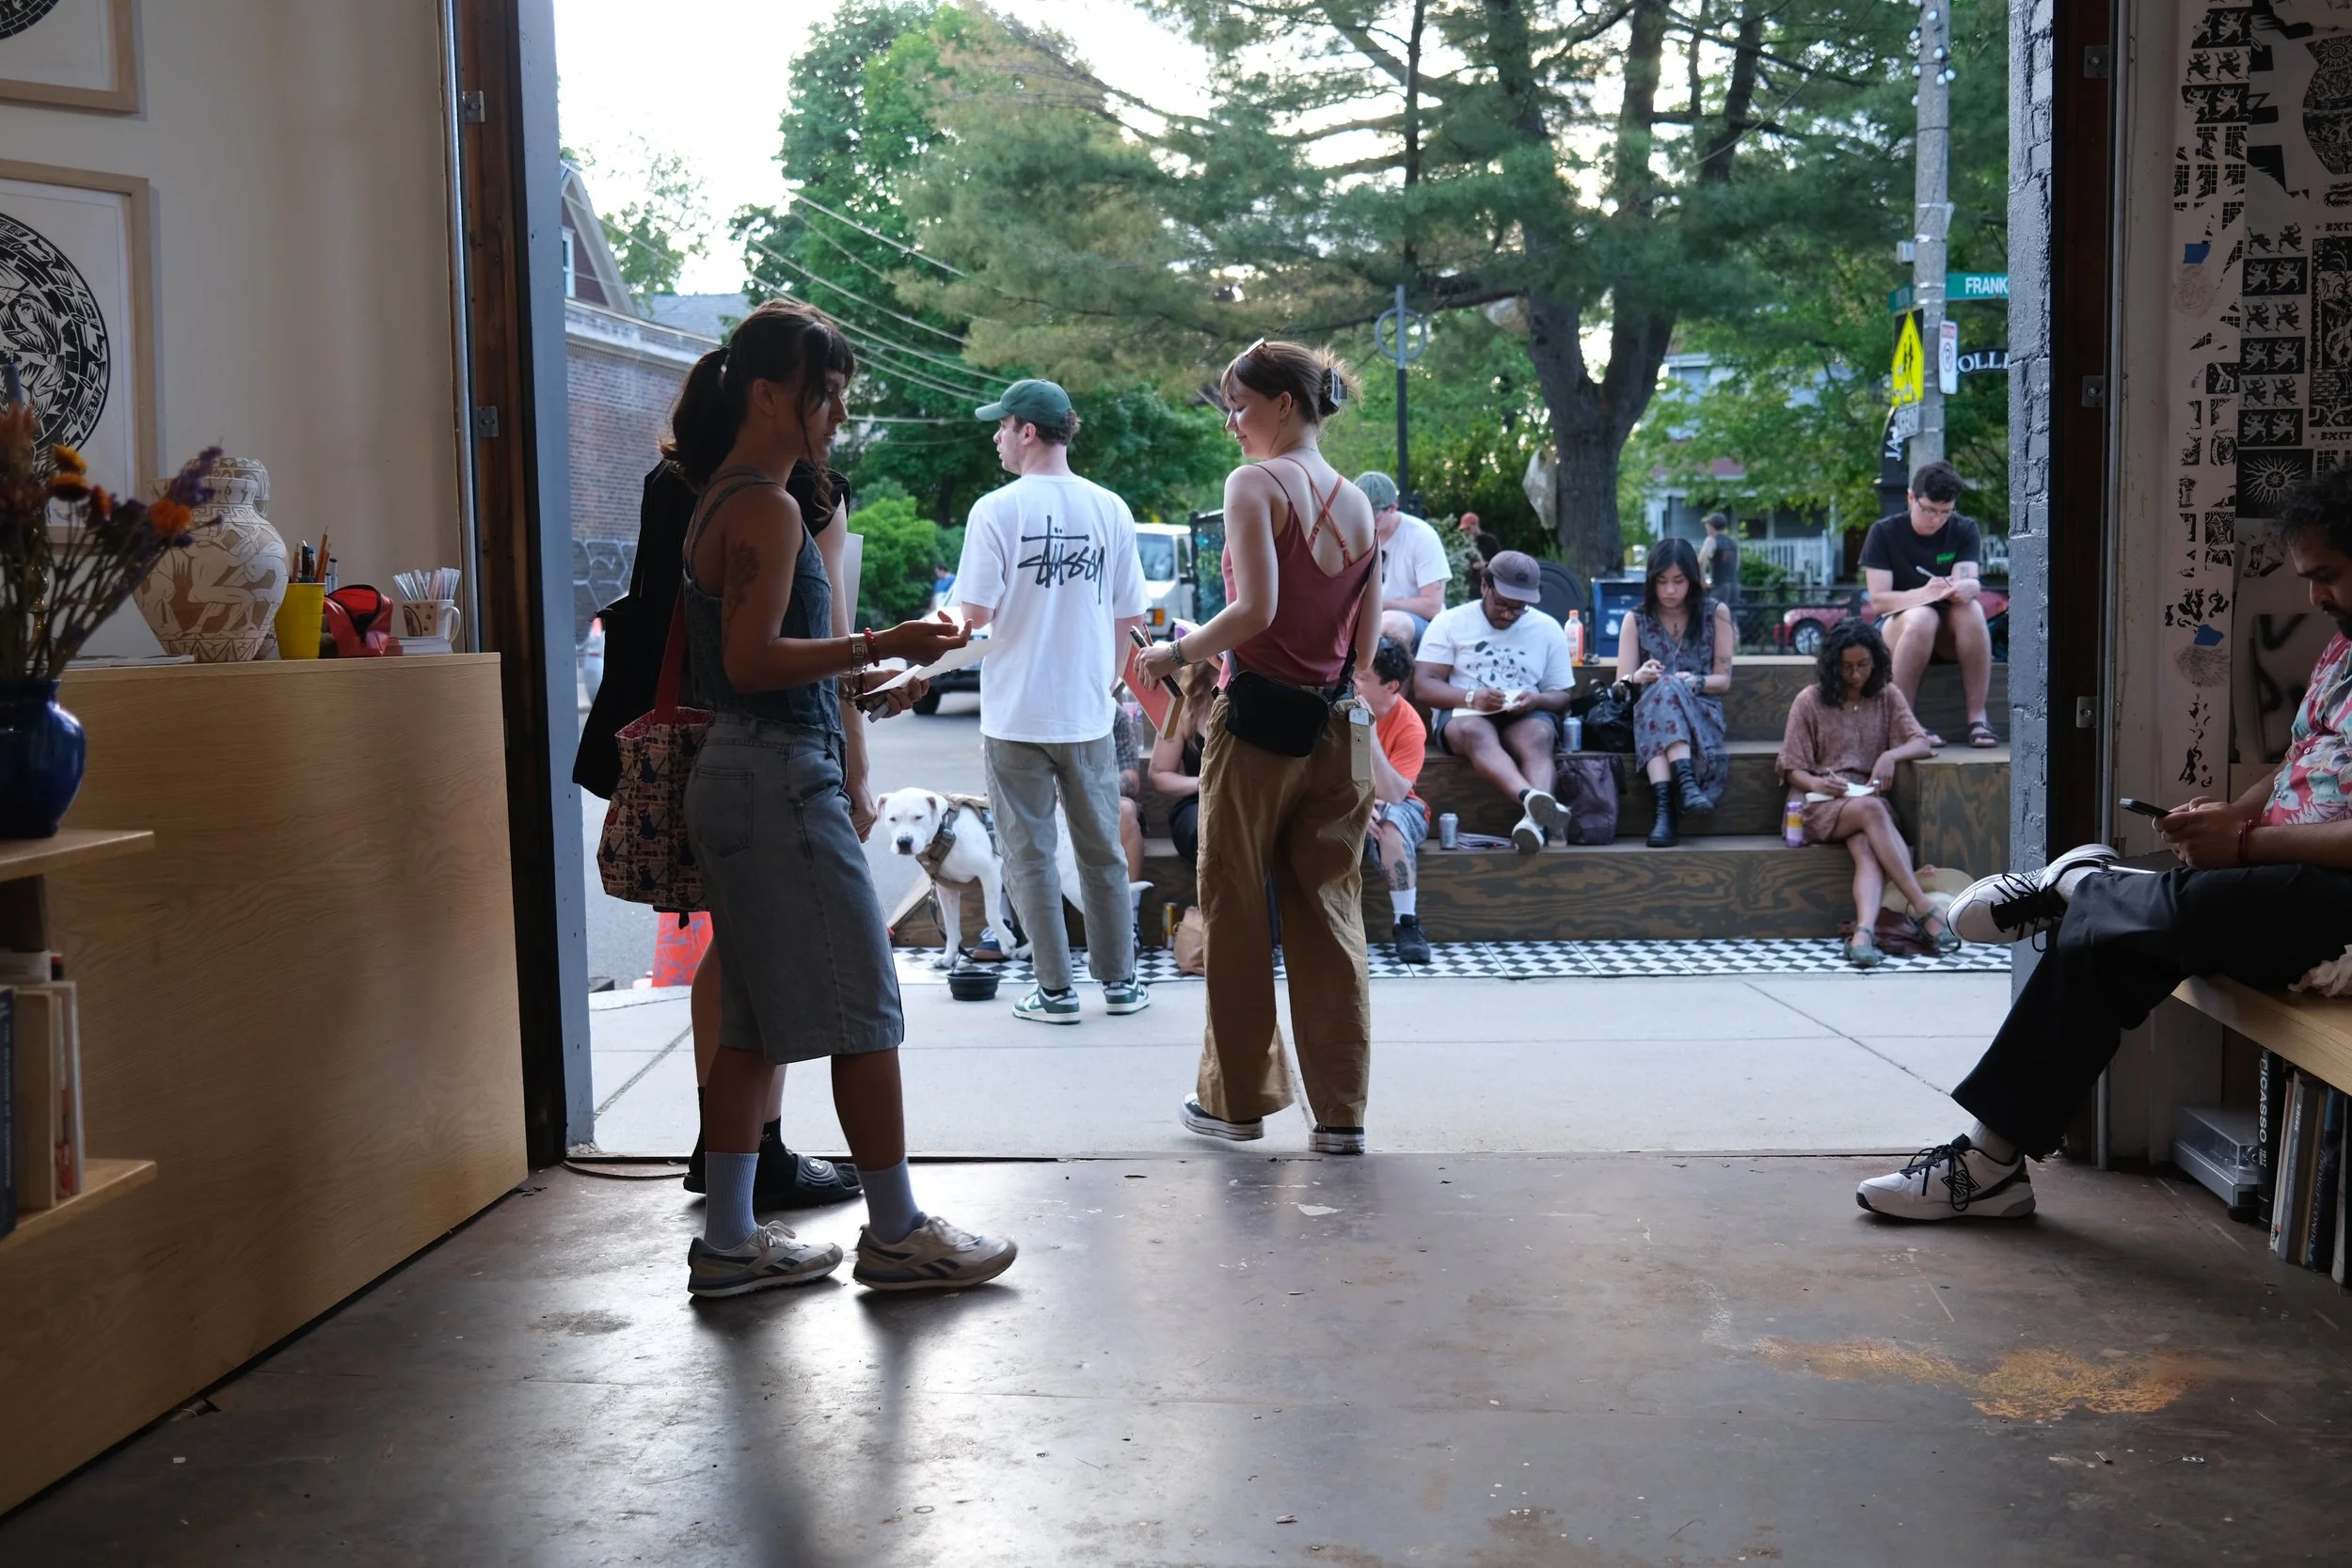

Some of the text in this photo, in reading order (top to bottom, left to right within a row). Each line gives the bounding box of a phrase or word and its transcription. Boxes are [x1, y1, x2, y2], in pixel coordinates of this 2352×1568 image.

[1965, 277, 2009, 294] FRANK
[2259, 1057, 2268, 1144] PICASSO
[2310, 1201, 2319, 1249] CONDO
